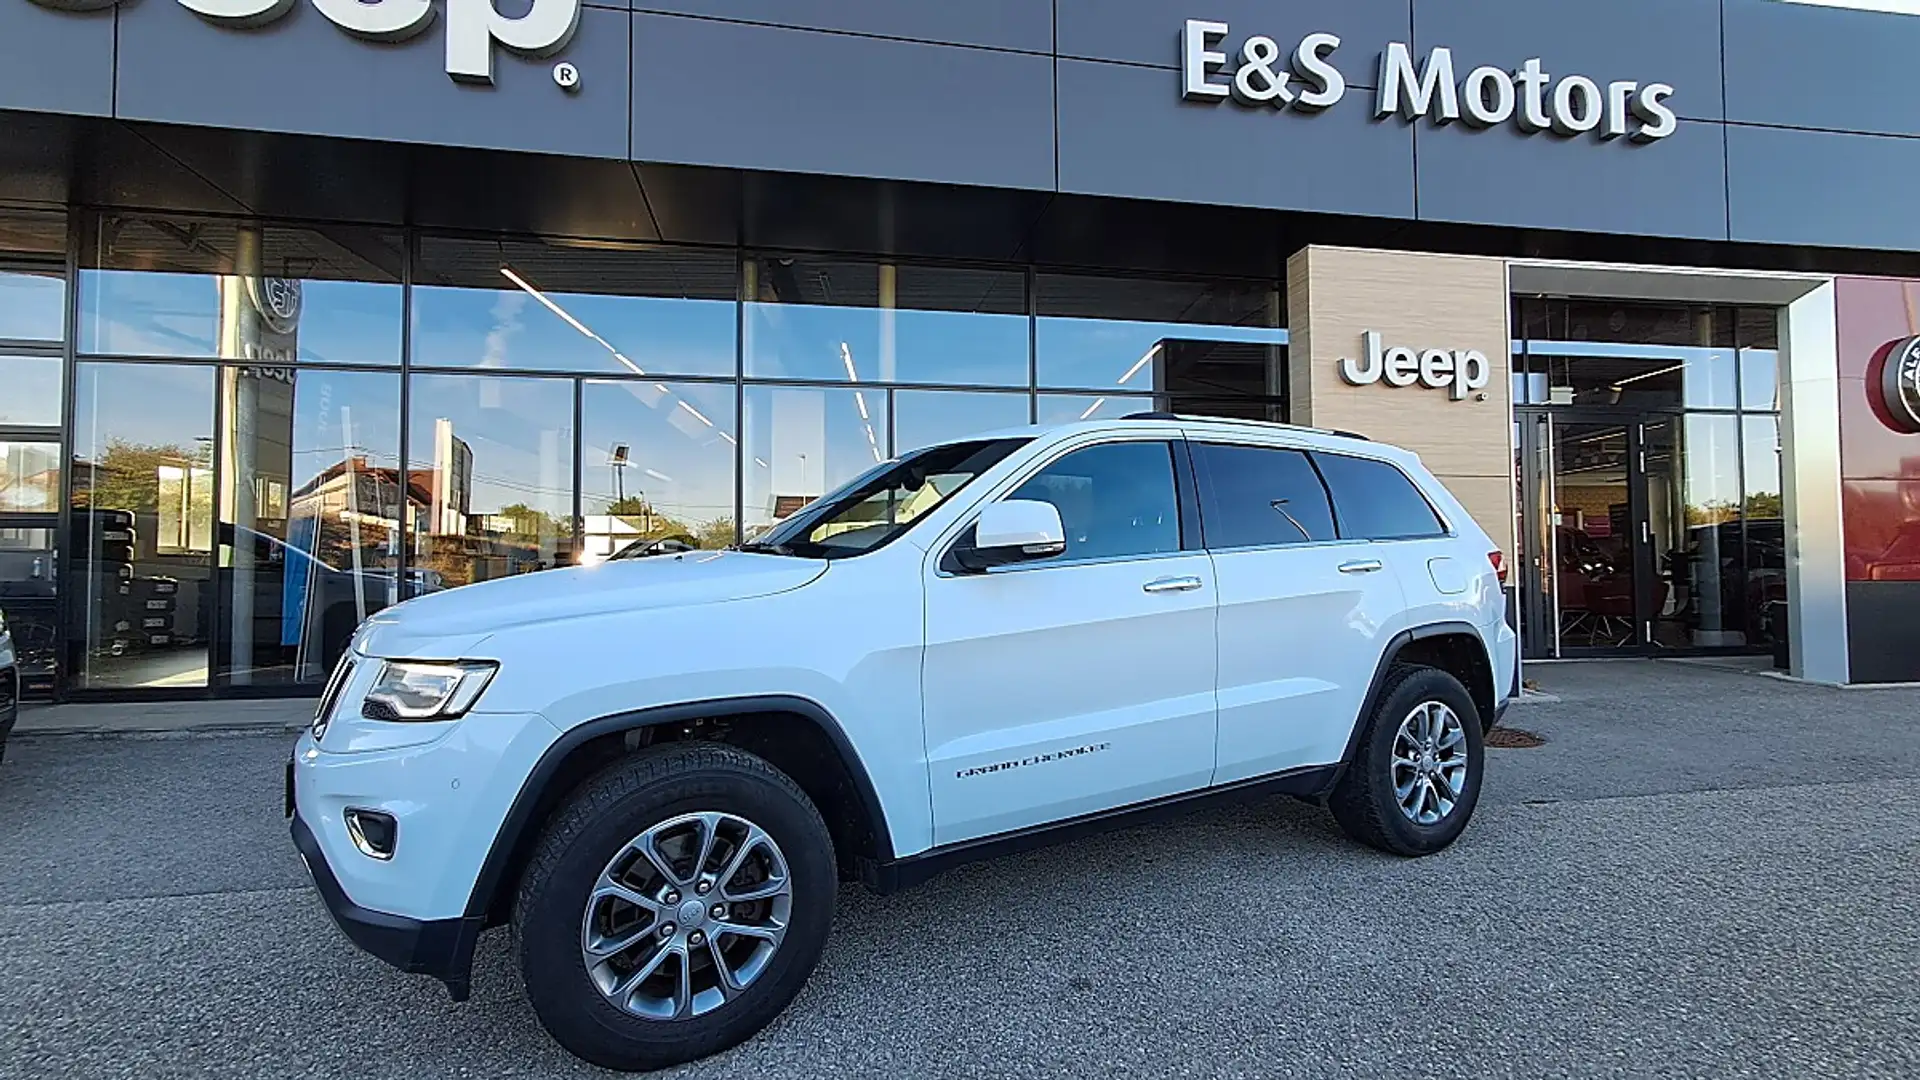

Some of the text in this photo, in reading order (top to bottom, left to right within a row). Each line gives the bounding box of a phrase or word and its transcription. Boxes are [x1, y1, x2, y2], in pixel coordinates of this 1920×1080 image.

[1181, 19, 1677, 141] E&S Motors
[1337, 330, 1489, 400] Jeep
[956, 742, 1112, 779] GRAND CHEROKEE
